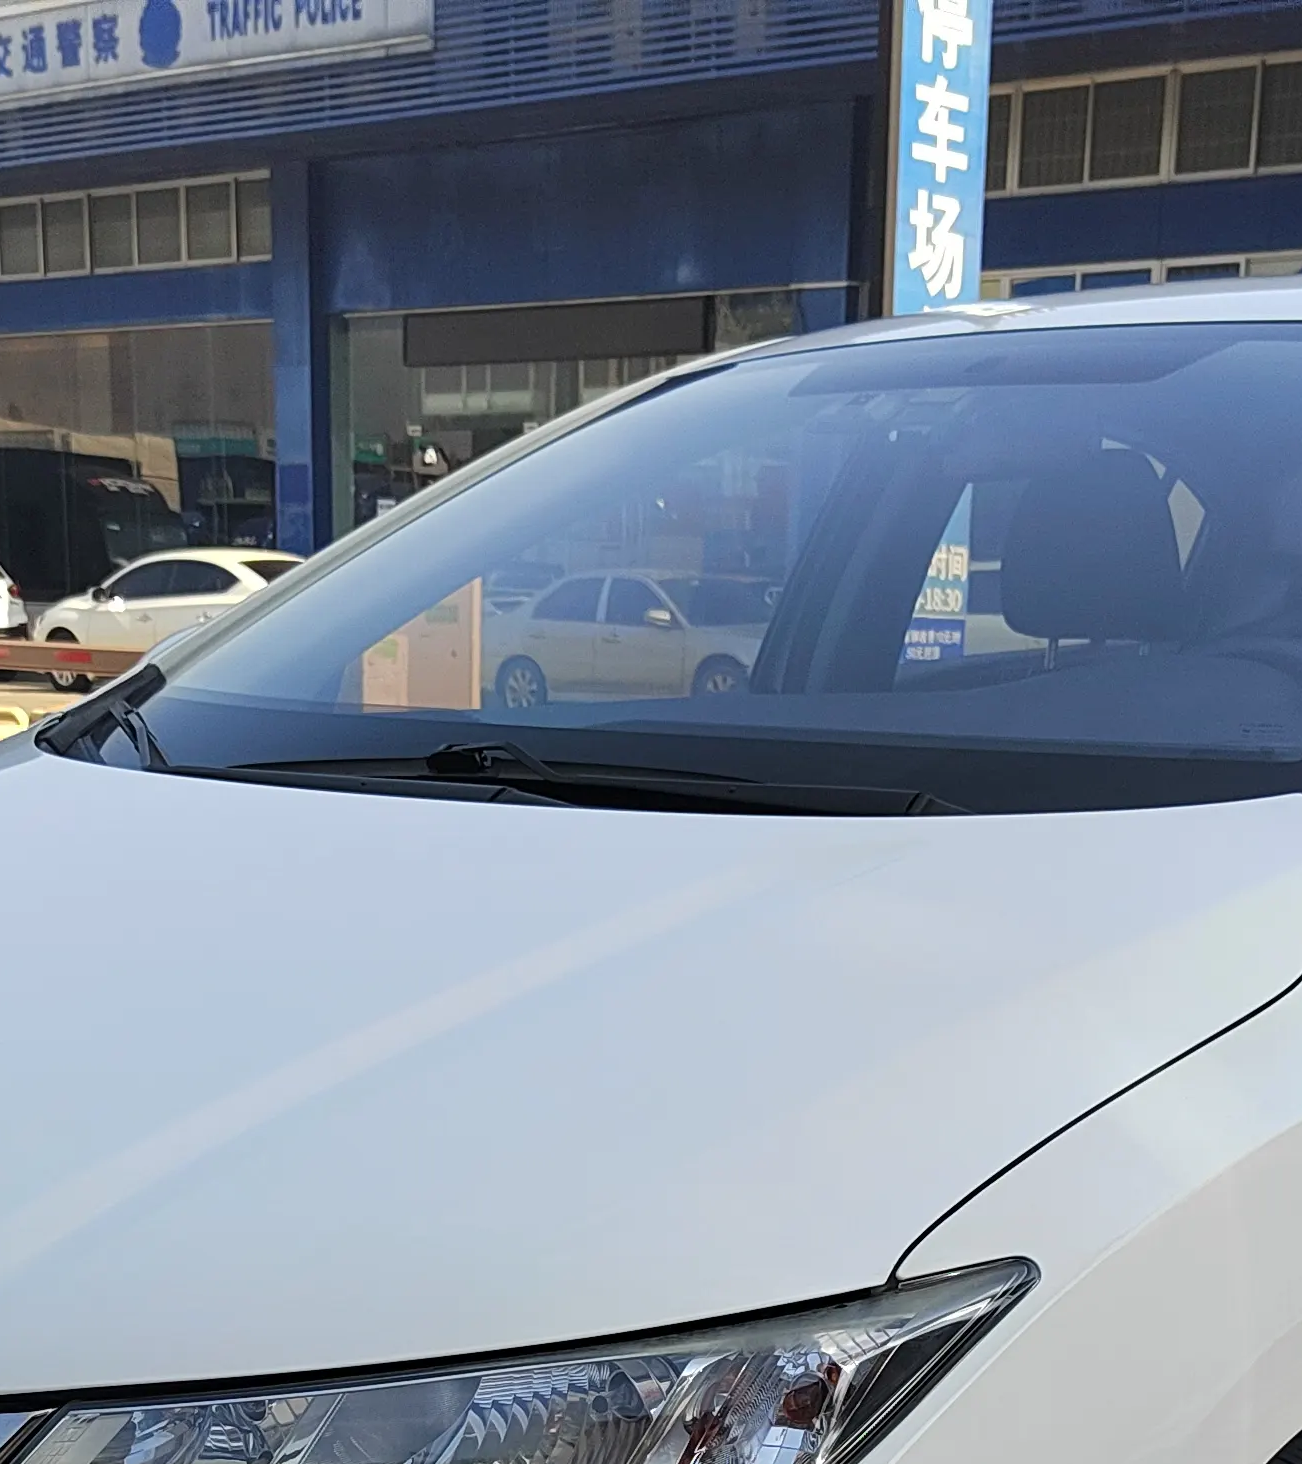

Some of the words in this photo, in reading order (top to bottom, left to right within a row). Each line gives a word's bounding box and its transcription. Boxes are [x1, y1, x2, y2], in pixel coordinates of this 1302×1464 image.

[207, 0, 283, 42] TRAFFIC
[294, 0, 363, 29] POLICE
[908, 0, 973, 299] 停车场
